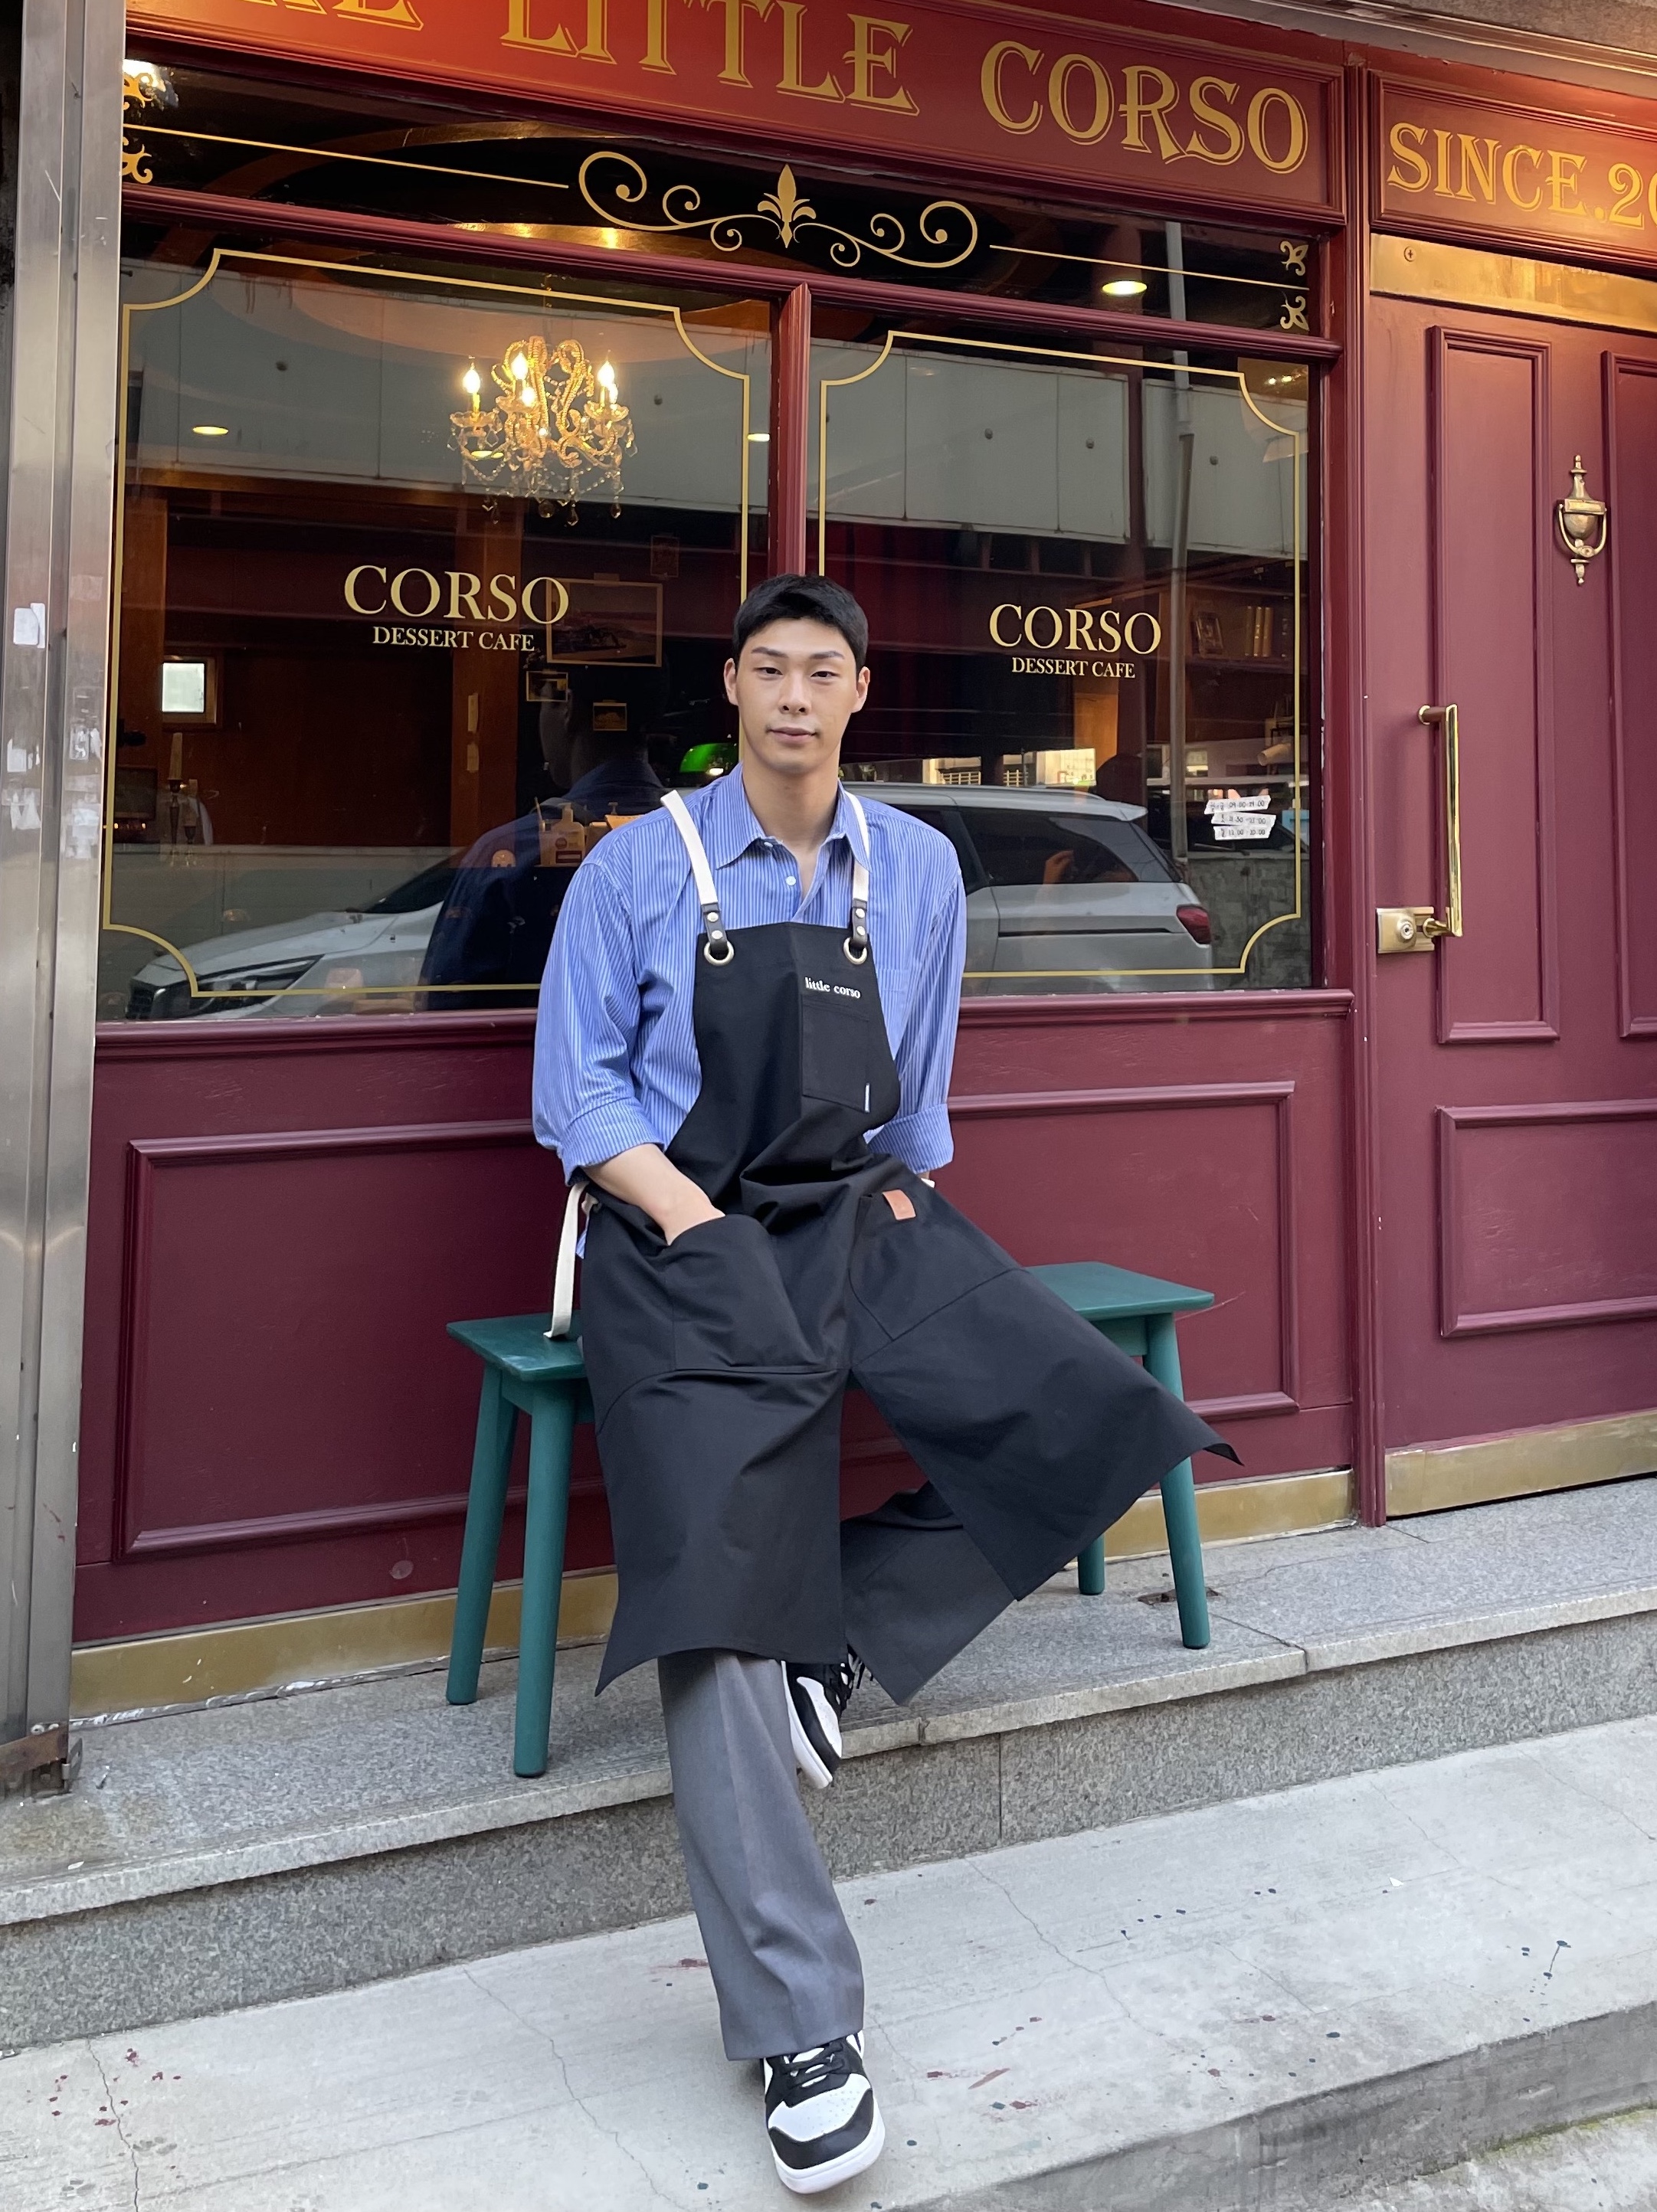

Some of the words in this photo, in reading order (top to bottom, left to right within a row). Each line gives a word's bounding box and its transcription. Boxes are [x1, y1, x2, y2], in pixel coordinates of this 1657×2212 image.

[980, 40, 1309, 175] CORSO
[1387, 122, 1657, 230] SINCE.2
[344, 564, 569, 624] CORSO
[372, 626, 473, 649] DESSERT
[478, 632, 535, 652] CAFE
[989, 604, 1162, 655] CORSO
[1012, 656, 1089, 676] DESSERT
[1092, 661, 1136, 679] CAFE
[804, 977, 831, 993] little
[833, 985, 862, 999] corso
